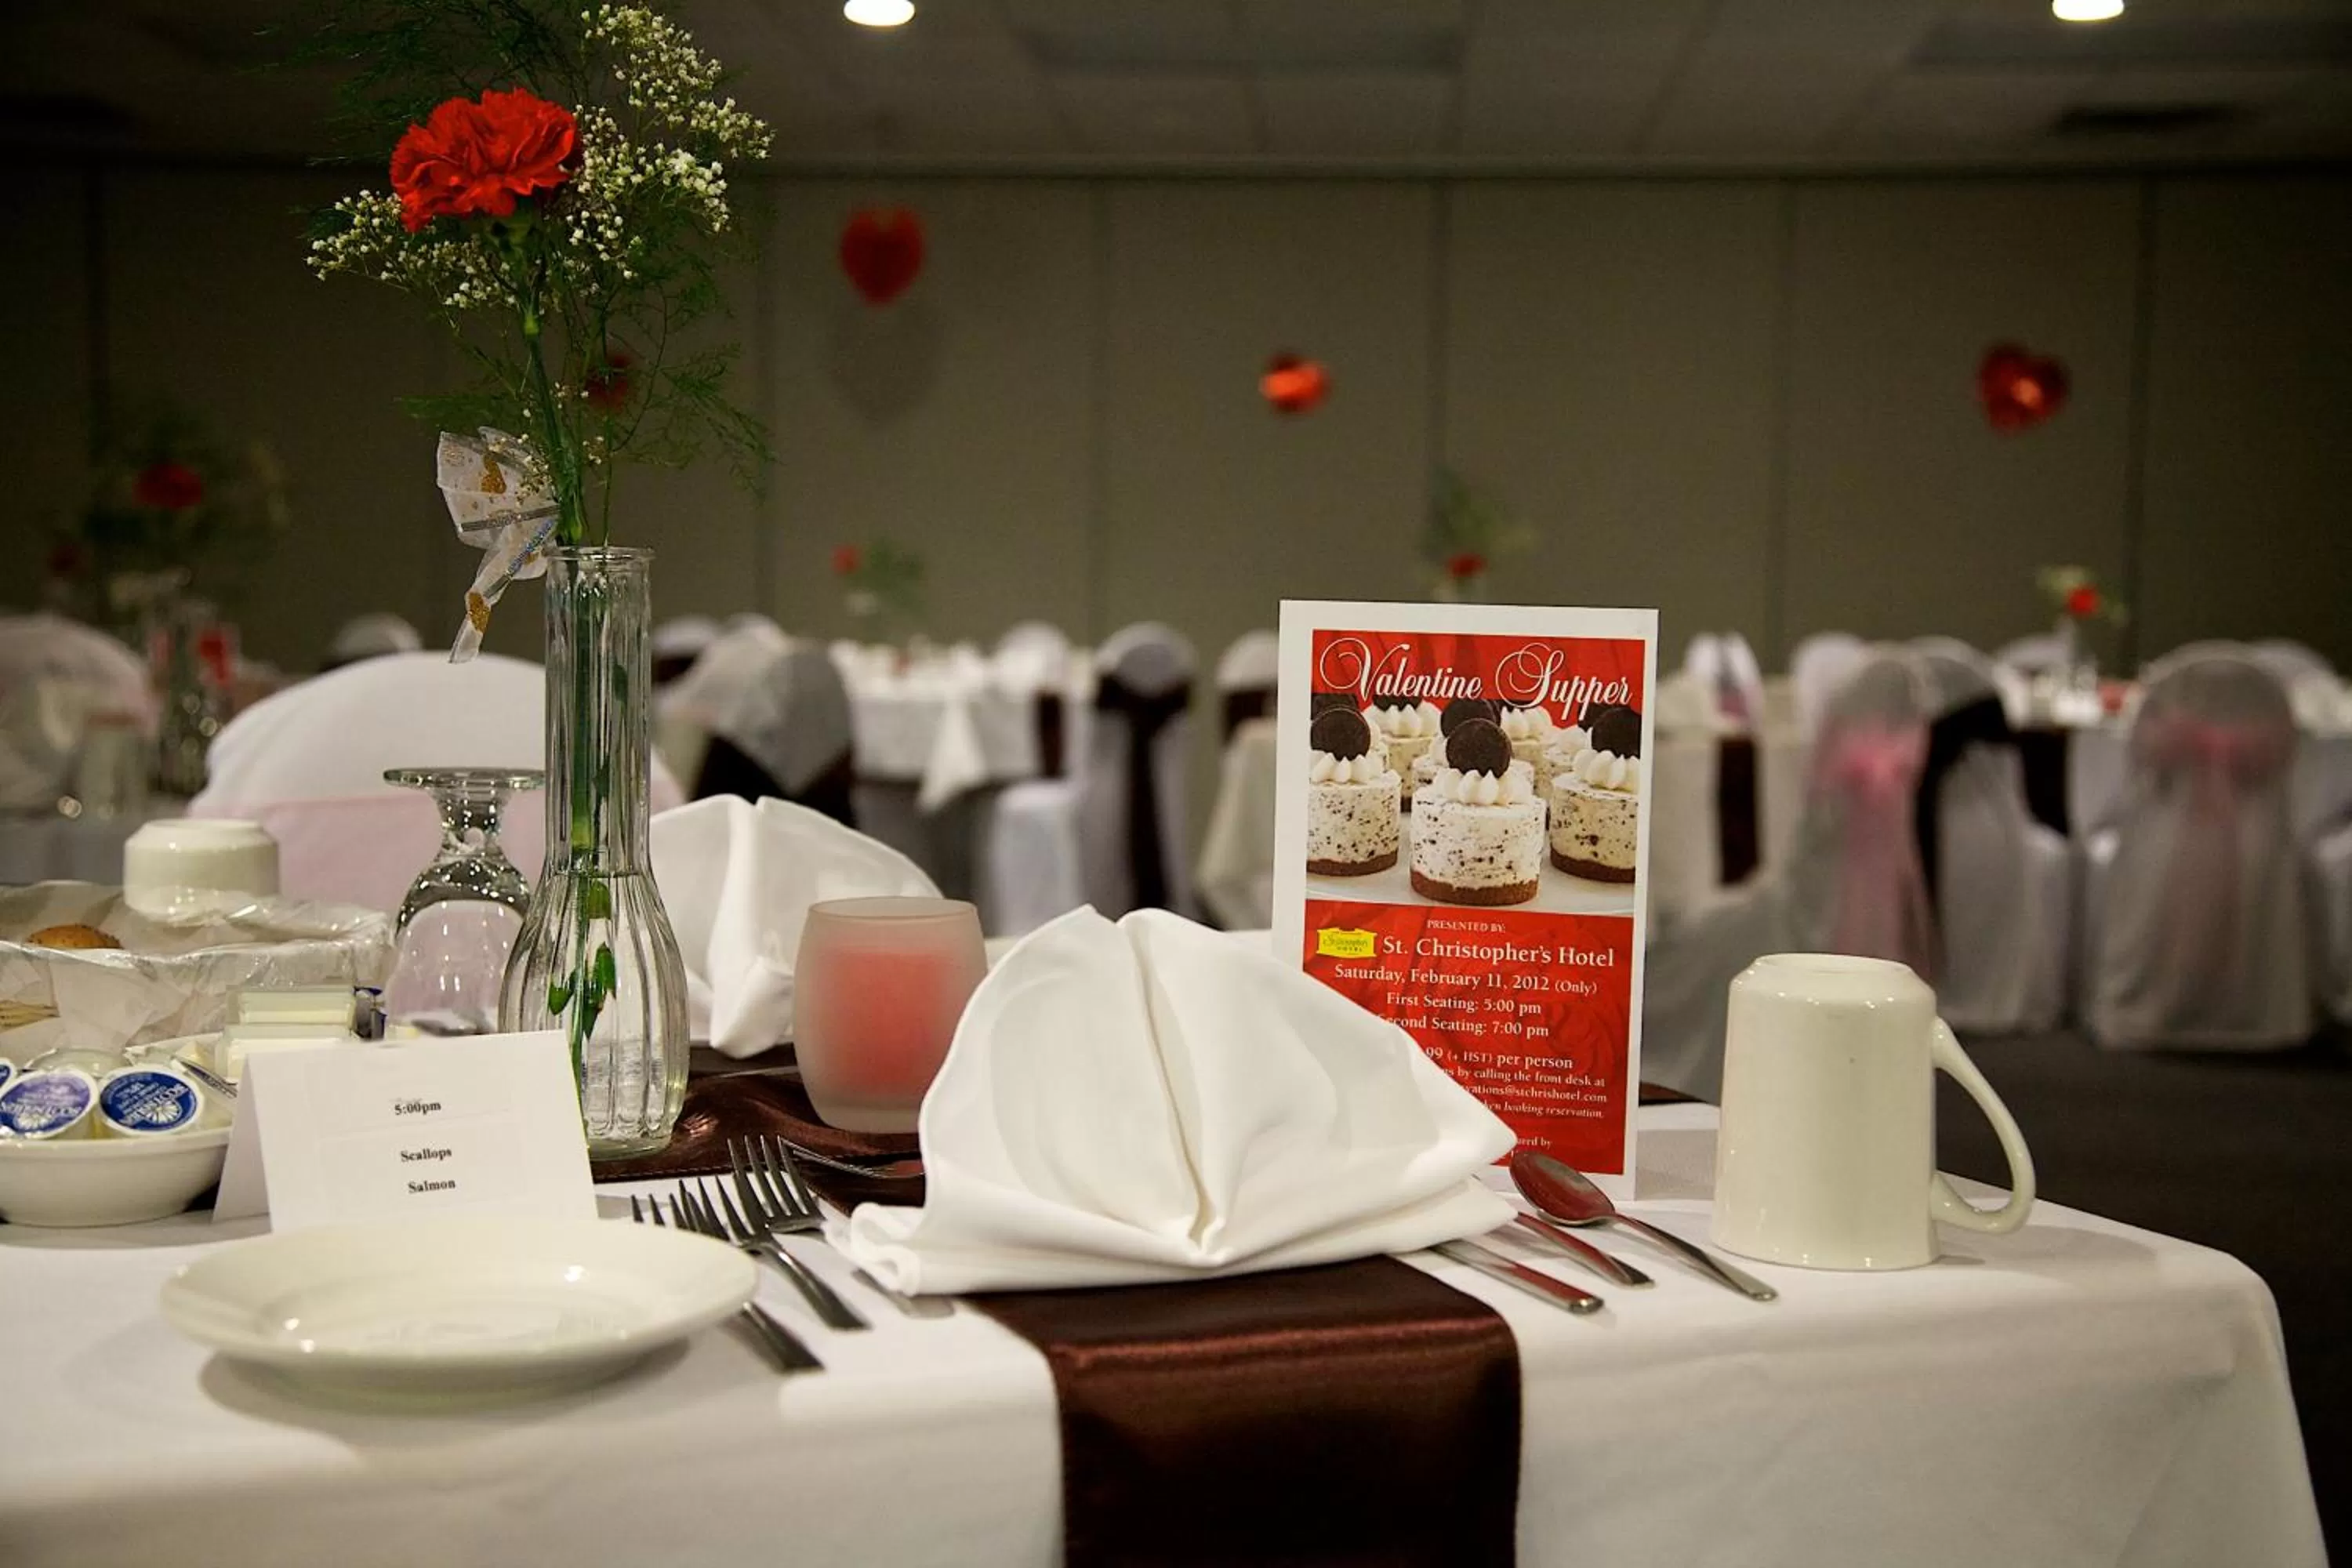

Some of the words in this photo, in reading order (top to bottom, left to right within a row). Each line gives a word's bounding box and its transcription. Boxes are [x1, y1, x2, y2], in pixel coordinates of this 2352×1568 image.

[1320, 637, 1483, 702] Valentine
[1496, 643, 1632, 720] Supper
[1427, 919, 1488, 931] PRESENTED
[1382, 935, 1407, 954] St.
[1416, 938, 1552, 965] Christopher's
[1559, 946, 1613, 967] Hotel
[1334, 964, 1405, 984] Saturday,
[1411, 968, 1480, 991] February
[1486, 973, 1508, 989] 11,
[1512, 975, 1549, 990] 2012
[1555, 980, 1597, 996] (Only)
[1387, 992, 1418, 1005] First
[1423, 994, 1479, 1013] Seating:
[1483, 999, 1514, 1012] 5:00
[1519, 1003, 1541, 1016] pm
[1381, 1016, 1426, 1028] econd
[1431, 1018, 1487, 1036] Seating:
[1492, 1022, 1521, 1034] 7:00
[1526, 1025, 1548, 1039] pm
[1497, 1054, 1520, 1067] per
[1525, 1057, 1573, 1069] person
[1458, 1066, 1471, 1080] by
[1474, 1068, 1511, 1083] calling
[1514, 1071, 1530, 1081] the
[1534, 1072, 1562, 1083] front
[1566, 1074, 1591, 1087] desk
[394, 1102, 441, 1116] 5:00pm
[1541, 1136, 1552, 1150] by
[401, 1148, 452, 1162] Scallops
[408, 1180, 456, 1194] Salmon
